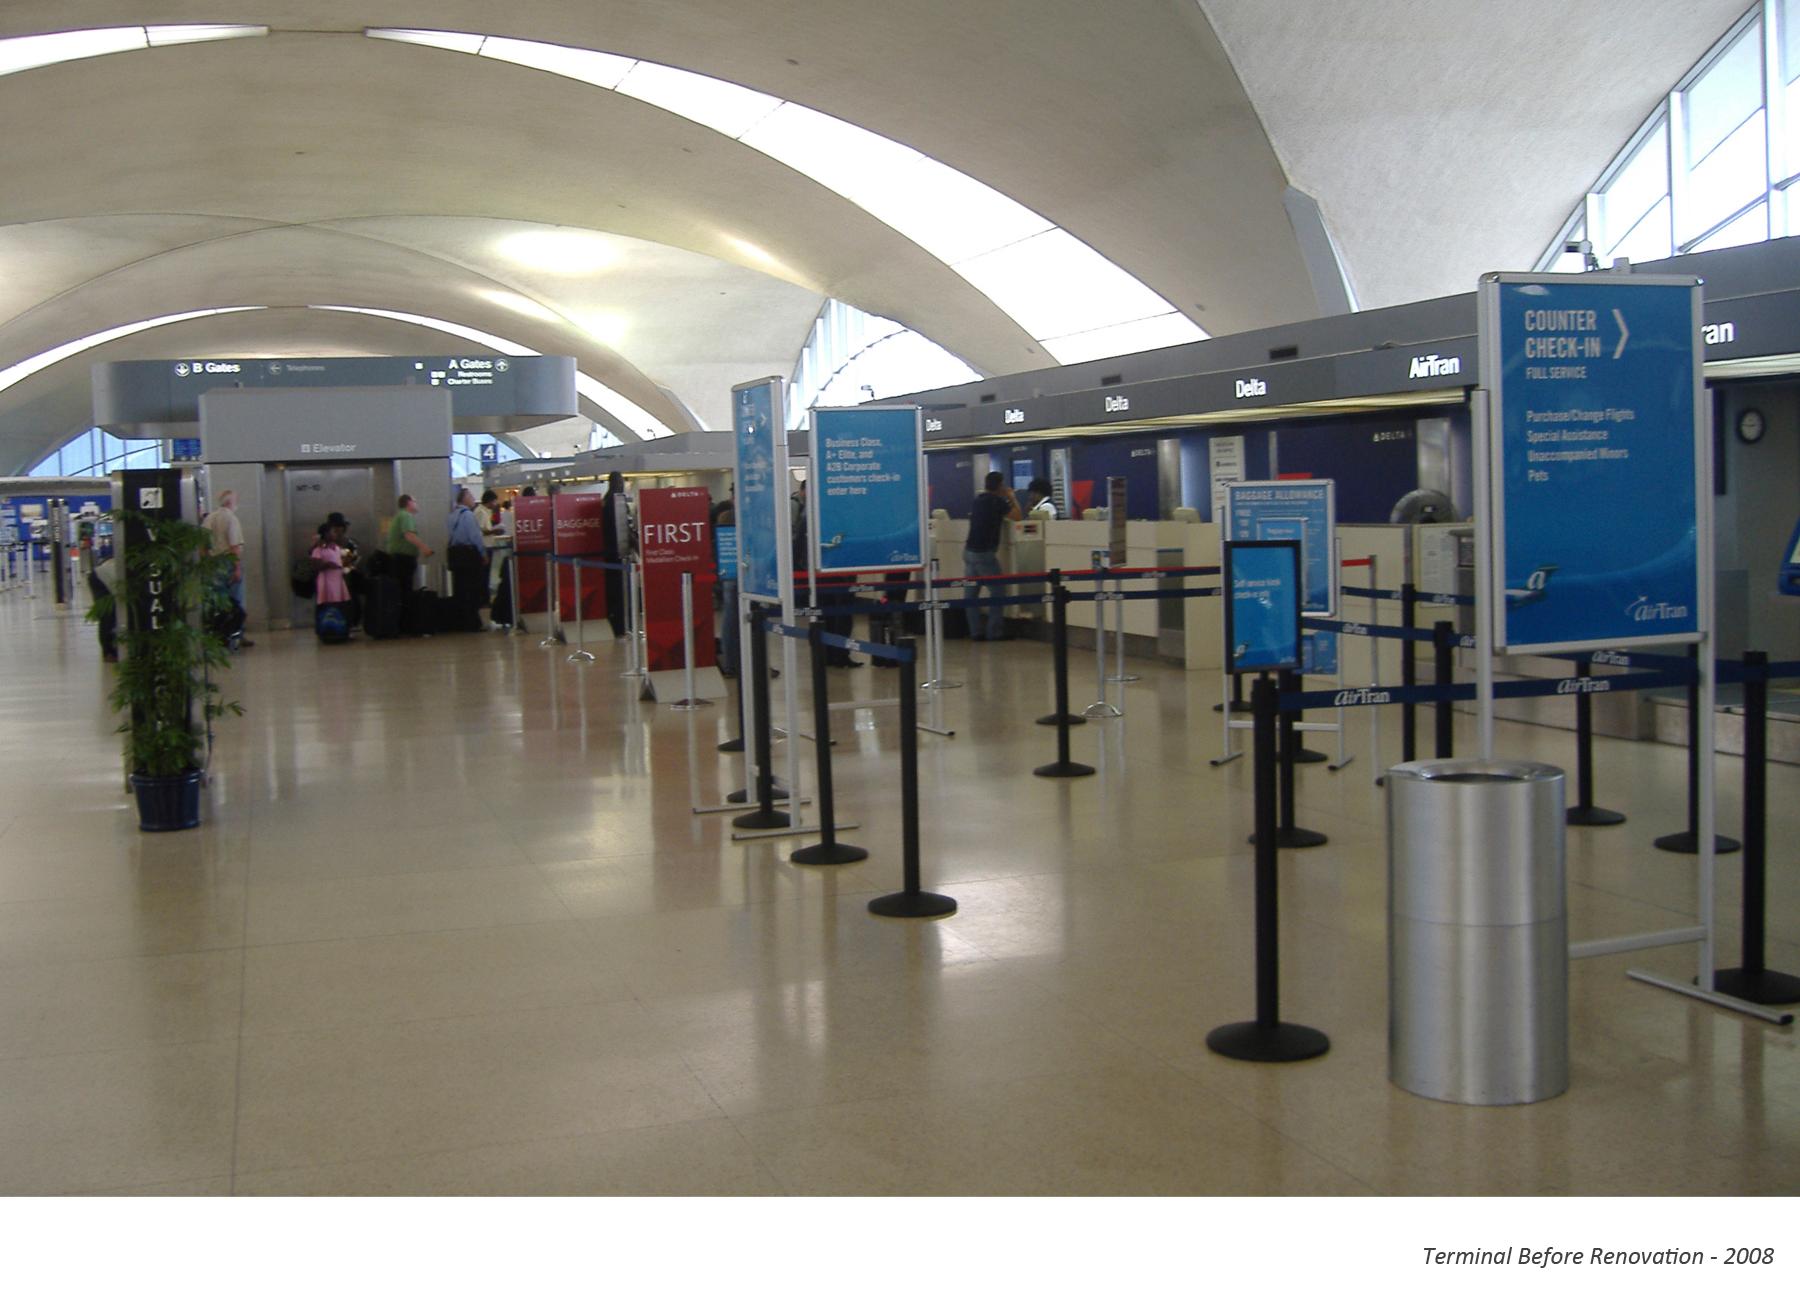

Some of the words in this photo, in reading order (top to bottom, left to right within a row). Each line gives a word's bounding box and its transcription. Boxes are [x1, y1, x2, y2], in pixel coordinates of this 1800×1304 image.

[1525, 309, 1597, 331] COUNTER
[1525, 337, 1601, 358] CHECK-IN
[192, 362, 203, 373] B
[205, 362, 241, 373] Gates
[448, 359, 459, 369] A
[460, 358, 493, 369] Gates
[1409, 354, 1461, 379] AirTran
[1526, 367, 1548, 379] FULL
[1549, 366, 1588, 379] SERVICE
[1235, 379, 1267, 398] Delta
[1105, 396, 1130, 412] Delta
[1004, 409, 1025, 424] Delta
[1528, 431, 1560, 443] Special
[313, 443, 356, 453] Elevator
[483, 446, 495, 459] 4
[1528, 470, 1550, 482] Pets
[516, 518, 544, 533] SELF
[557, 518, 601, 529] BAGGAGE
[643, 521, 706, 544] FIRST
